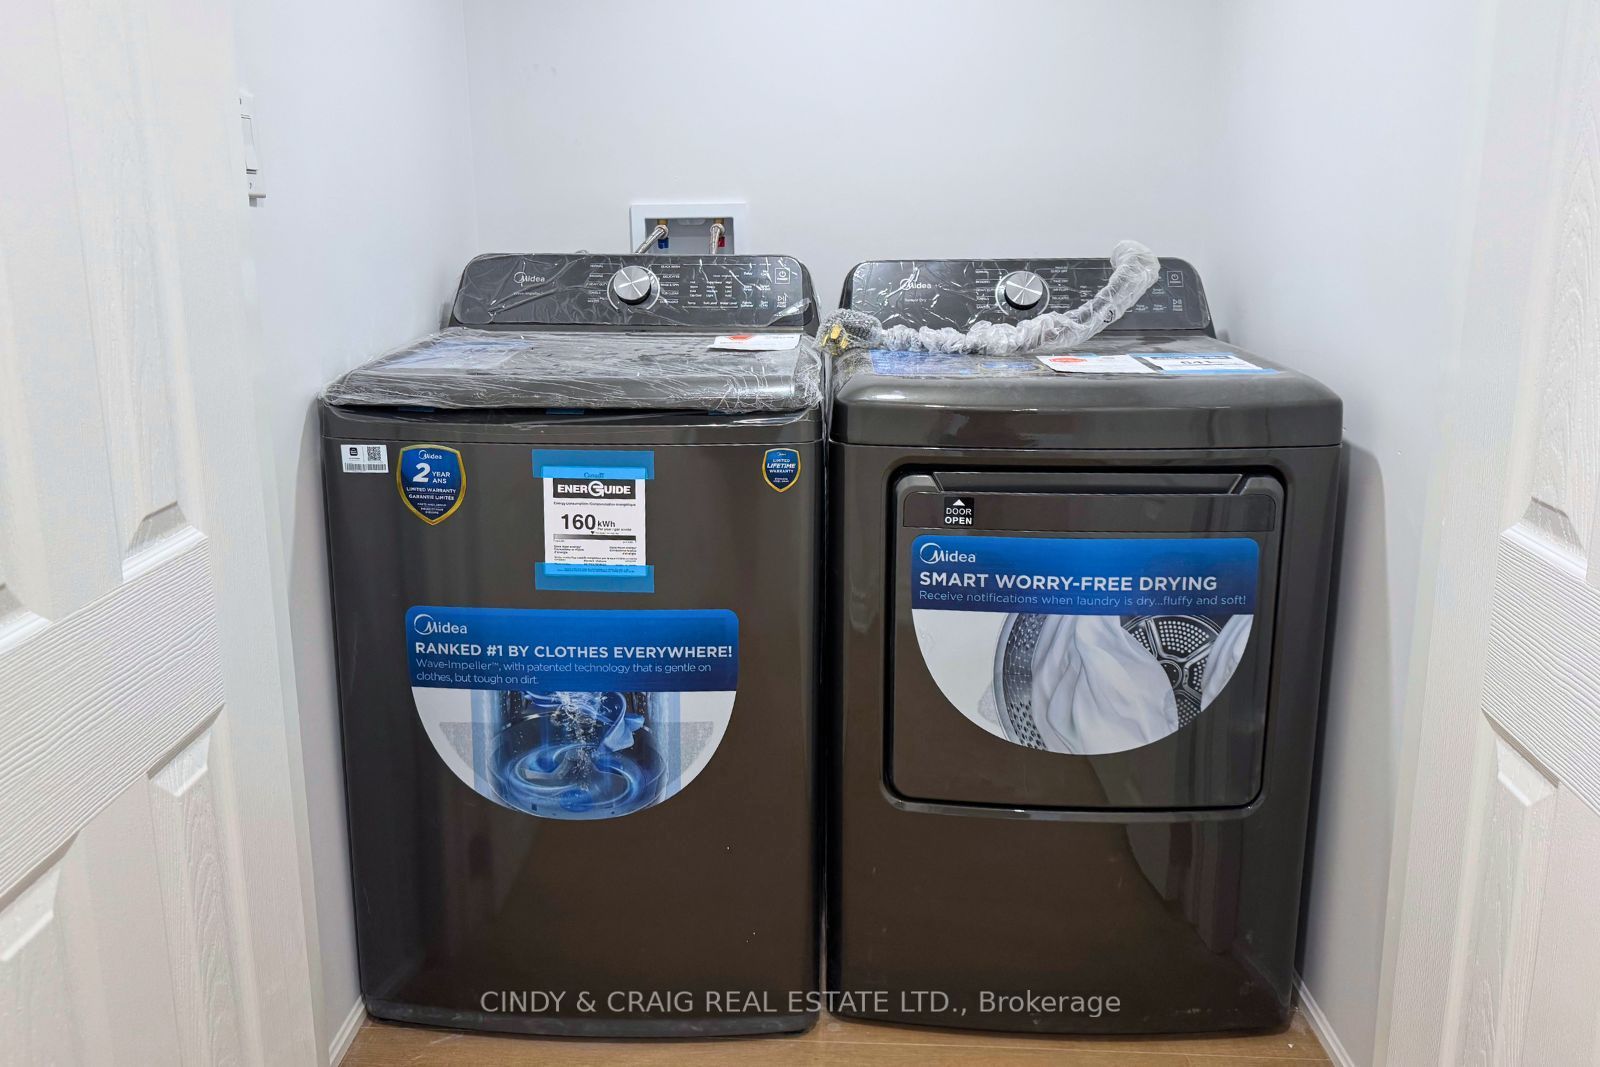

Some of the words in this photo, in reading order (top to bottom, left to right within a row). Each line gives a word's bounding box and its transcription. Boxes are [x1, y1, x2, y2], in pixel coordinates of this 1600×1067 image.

[514, 272, 545, 284] Midea
[900, 278, 931, 290] Midea
[418, 450, 442, 460] Midea
[412, 462, 431, 483] 2
[557, 481, 631, 497] ENERGUIDE
[946, 507, 972, 516] DOOR
[561, 514, 596, 530] 160
[597, 520, 616, 528] kWh
[944, 516, 973, 525] OPEN
[919, 542, 976, 564] Midea
[919, 571, 989, 588] SMART
[995, 574, 1133, 591] WORRY-FREE
[1139, 576, 1217, 591] DRYING
[919, 590, 964, 601] Receive
[966, 592, 1037, 604] notifications
[1041, 595, 1073, 605] when
[1076, 595, 1120, 608] laundry
[1124, 596, 1132, 606] is
[1196, 595, 1217, 605] and
[1221, 595, 1246, 605] soft!
[413, 613, 468, 635] Midea
[415, 642, 482, 656] RANKED
[486, 644, 503, 657] #1
[508, 645, 528, 658] BY
[534, 646, 608, 658] CLOTHES
[613, 646, 733, 658] EVERYWHERE!
[503, 663, 524, 671] with
[527, 663, 571, 673] patented
[574, 663, 629, 674] technology
[632, 663, 652, 672] that
[655, 663, 662, 672] is
[665, 663, 696, 674] gentle
[699, 664, 711, 672] on
[416, 672, 453, 684] clothes,
[455, 673, 471, 683] but
[473, 674, 503, 685] tough
[505, 676, 518, 684] on
[520, 674, 539, 685] dirt.
